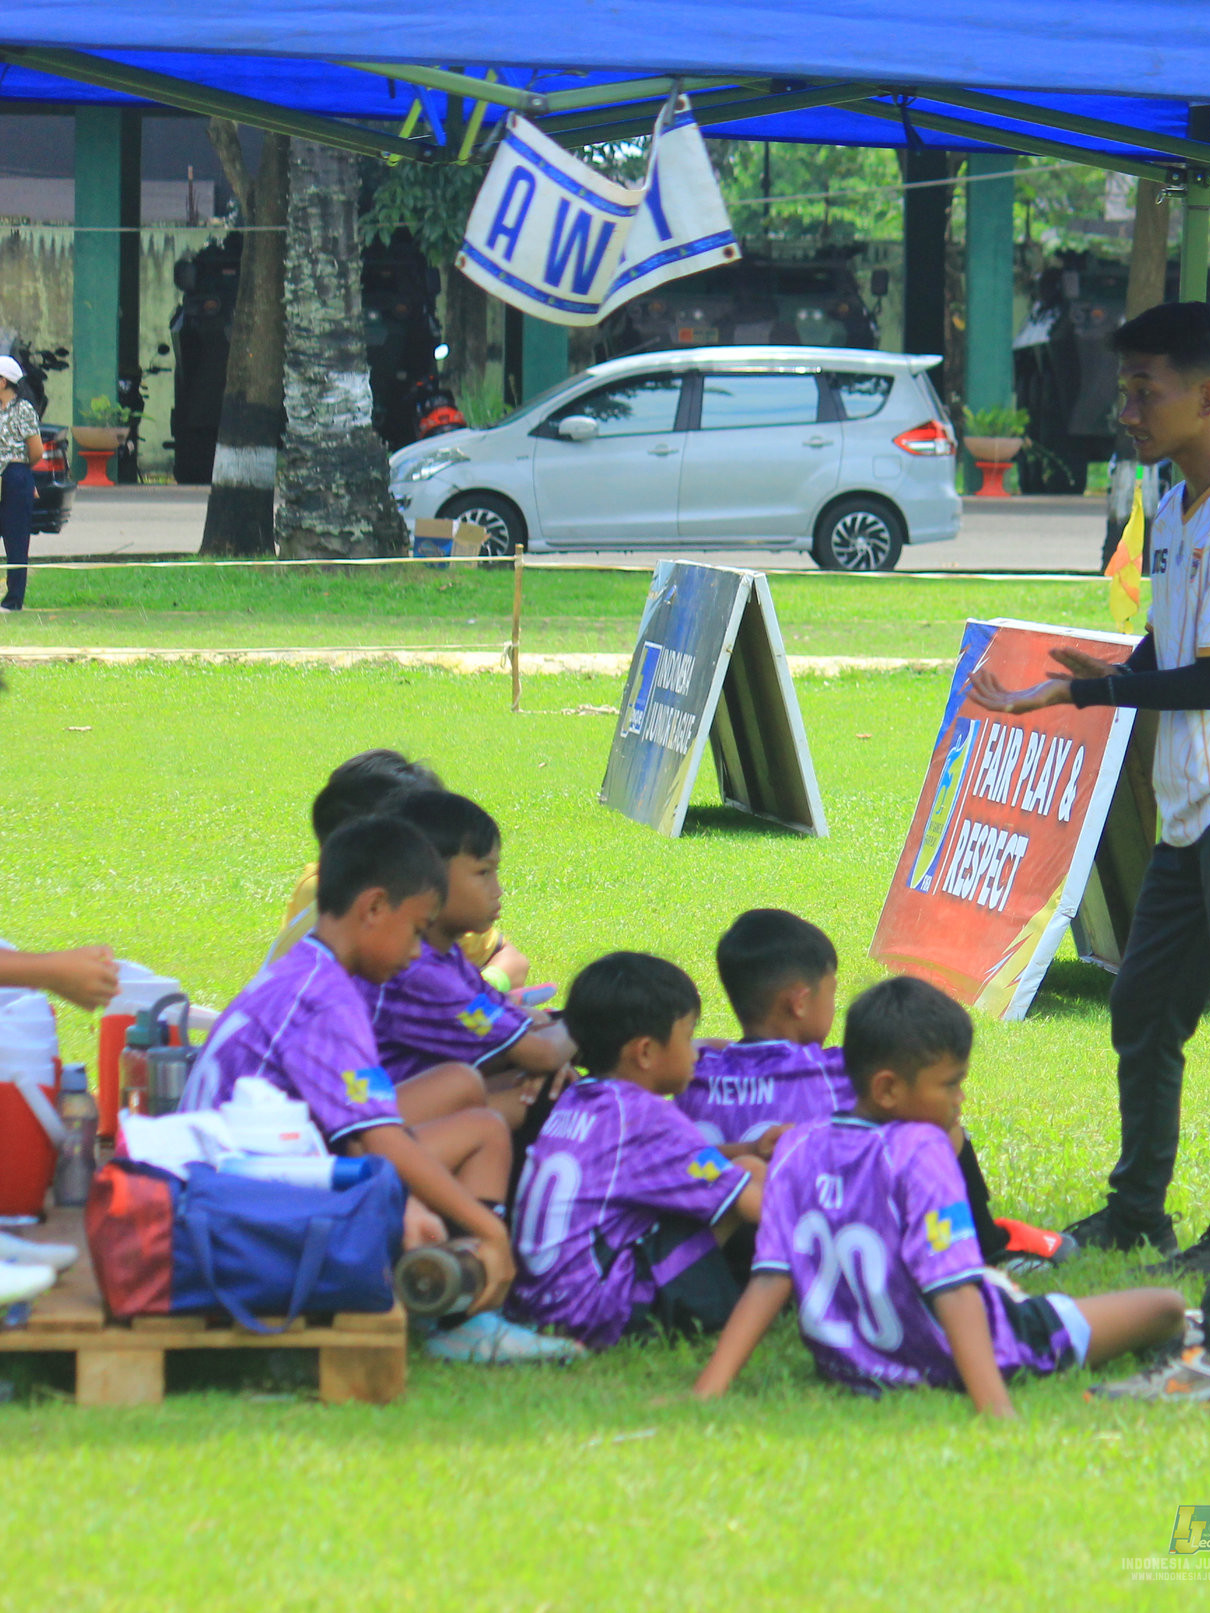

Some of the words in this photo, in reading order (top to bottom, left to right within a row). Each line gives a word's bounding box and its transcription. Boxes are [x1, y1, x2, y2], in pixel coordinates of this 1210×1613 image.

[486, 158, 673, 296] AWY
[972, 722, 1024, 805] FAIR
[1010, 731, 1073, 816] PLAY
[1058, 745, 1086, 823] &
[942, 818, 1029, 912] RESPECT
[707, 1075, 774, 1106] KEVIN
[793, 1209, 903, 1353] 20
